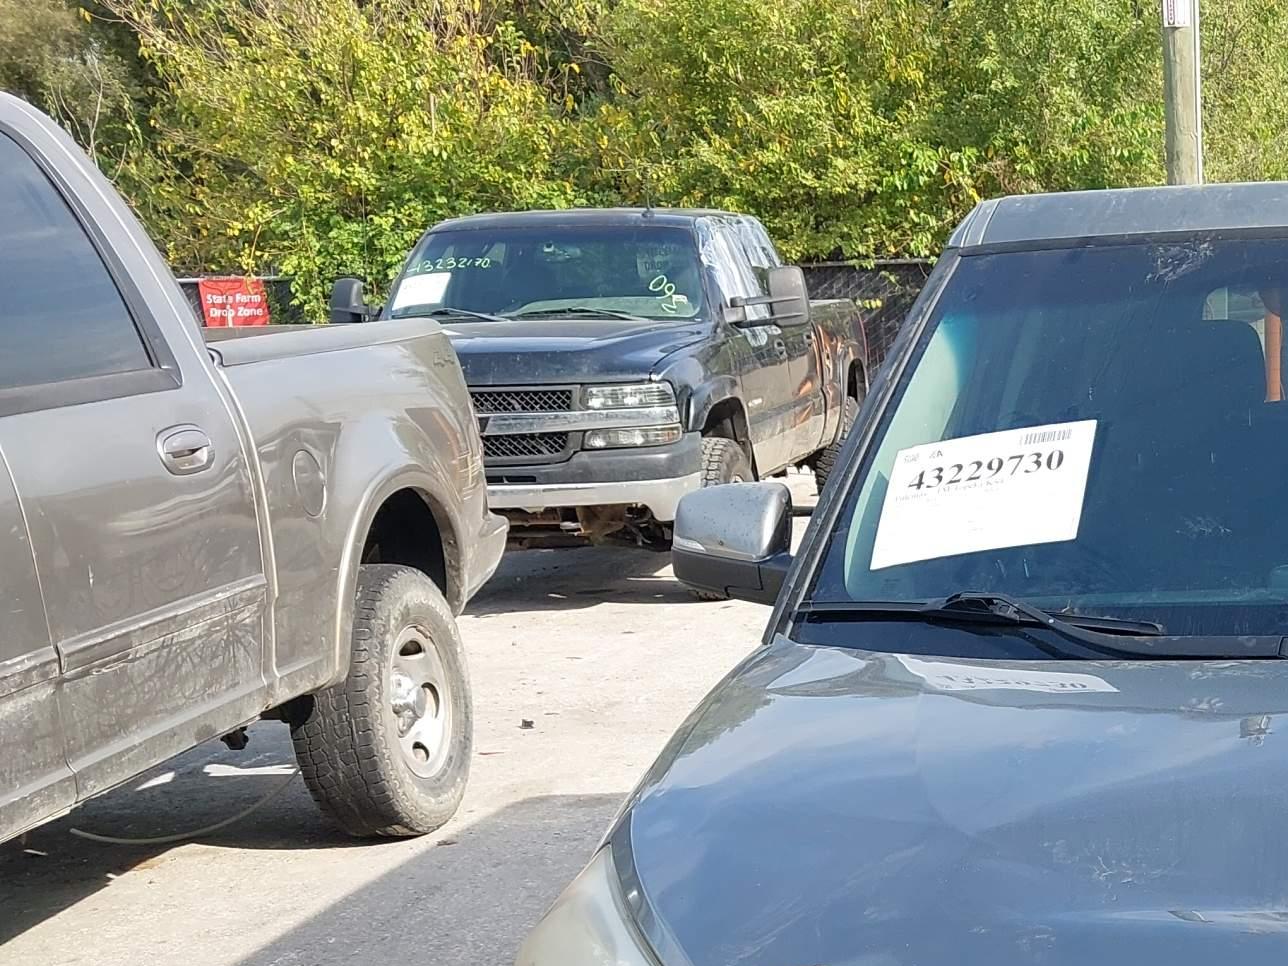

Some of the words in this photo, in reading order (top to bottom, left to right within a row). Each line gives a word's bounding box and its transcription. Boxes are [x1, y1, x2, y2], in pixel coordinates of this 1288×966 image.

[206, 293, 234, 304] State
[235, 292, 262, 303] Farm
[209, 307, 235, 318] Drop
[237, 306, 264, 317] Zone
[907, 449, 1065, 491] 43229730
